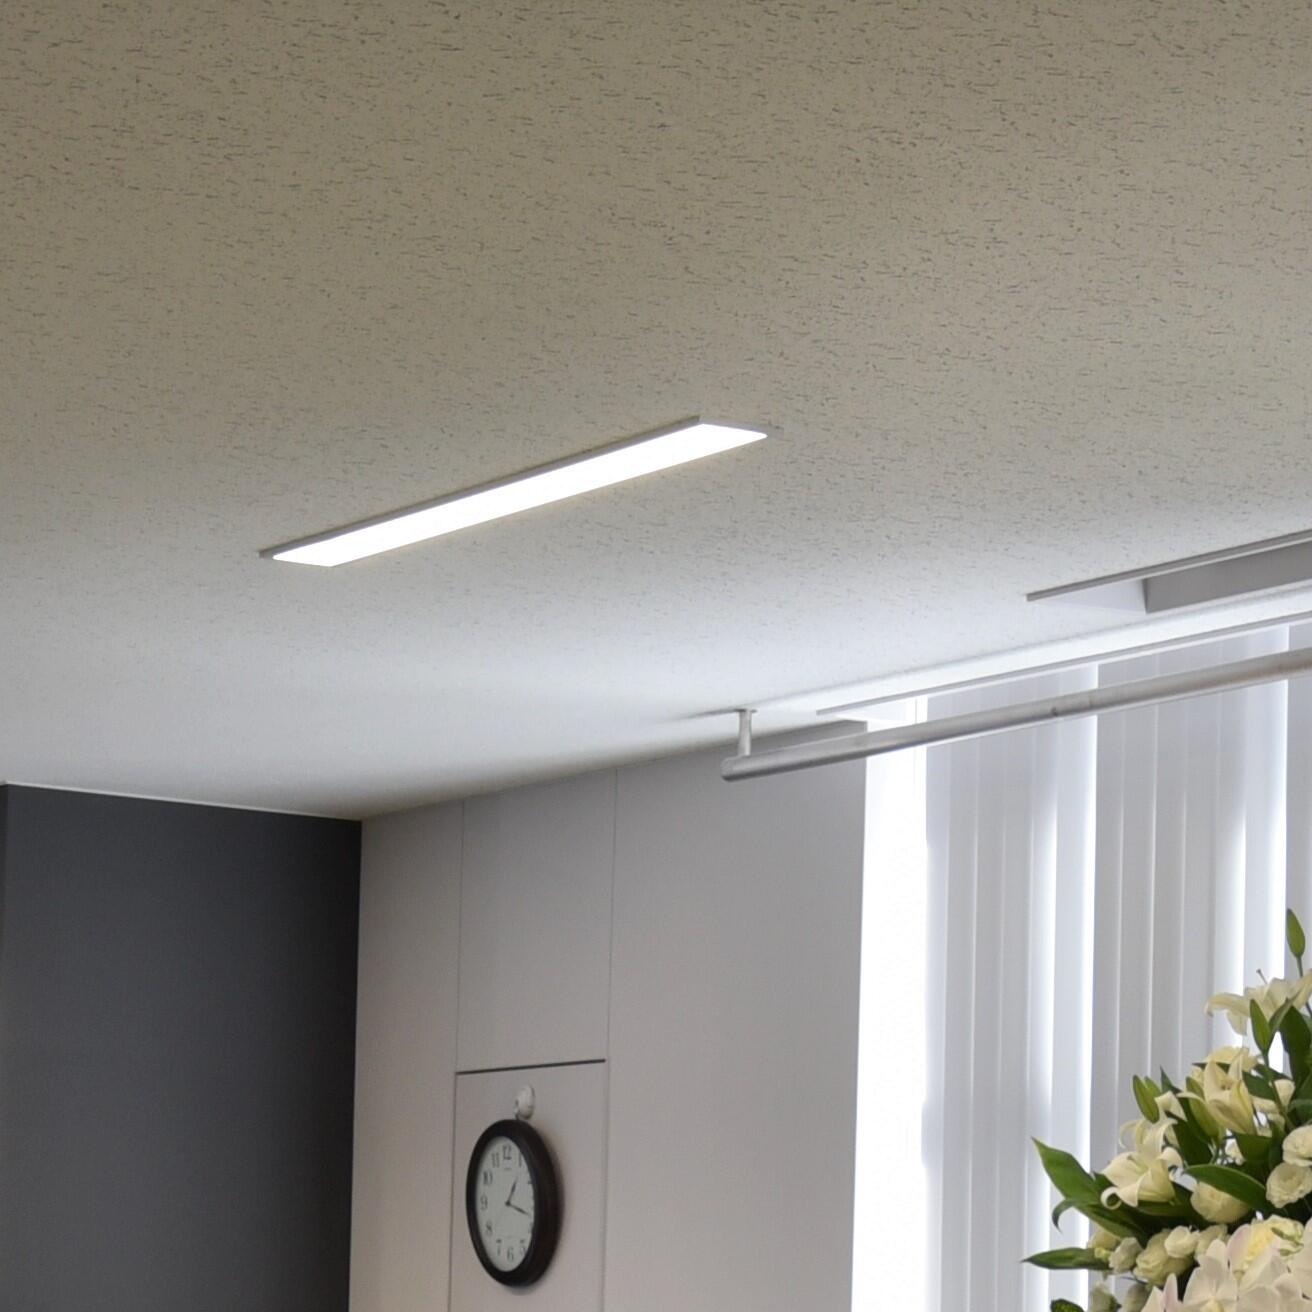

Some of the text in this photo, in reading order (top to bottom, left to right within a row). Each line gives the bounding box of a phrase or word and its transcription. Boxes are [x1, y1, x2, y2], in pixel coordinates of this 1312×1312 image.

[492, 1152, 500, 1168] 11
[502, 1144, 512, 1160] 12
[483, 1170, 493, 1186] 10
[480, 1194, 488, 1211] 9
[485, 1220, 493, 1237] 8
[496, 1238, 502, 1256] 7
[506, 1246, 514, 1263] 6
[519, 1238, 527, 1256] 5
